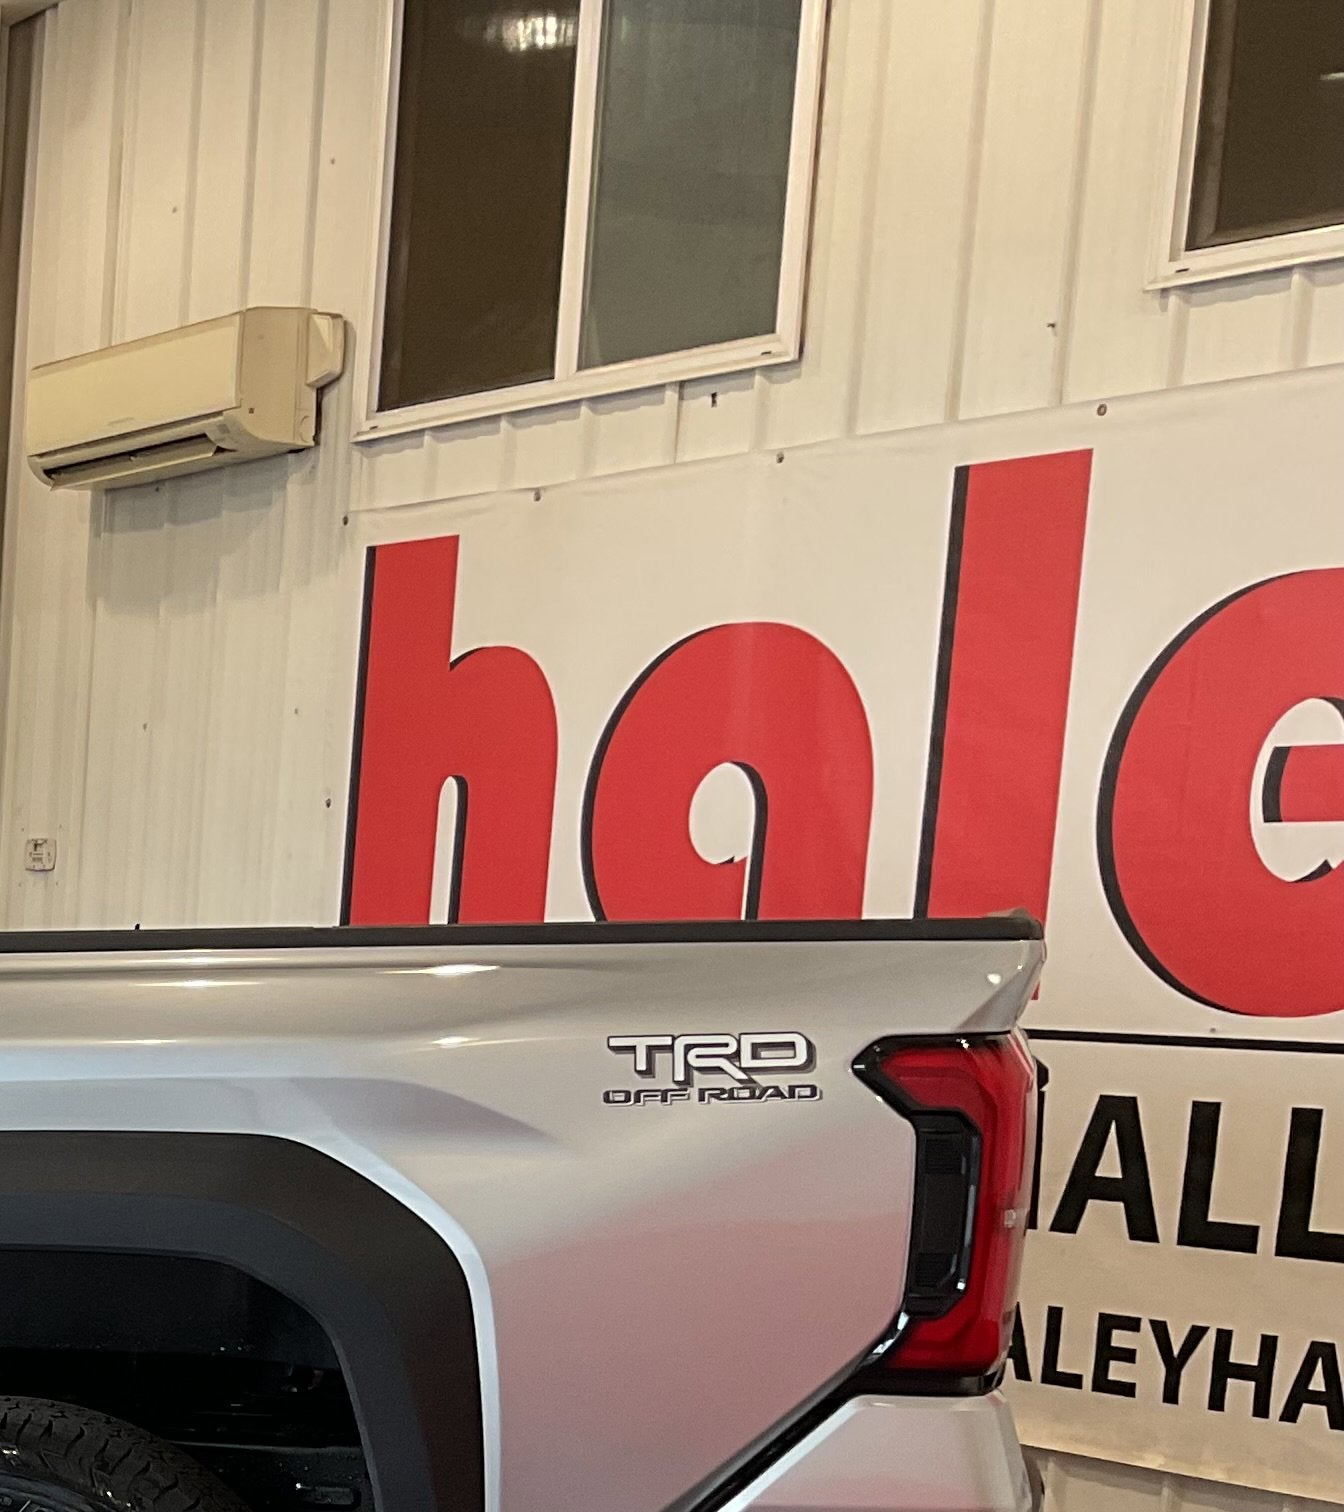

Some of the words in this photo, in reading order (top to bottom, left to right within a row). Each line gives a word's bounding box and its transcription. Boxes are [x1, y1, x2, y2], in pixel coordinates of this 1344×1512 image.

[608, 1032, 816, 1086] TRD
[603, 1088, 690, 1106] OFF
[698, 1084, 823, 1105] ROAD
[1027, 1090, 1344, 1264] ALL
